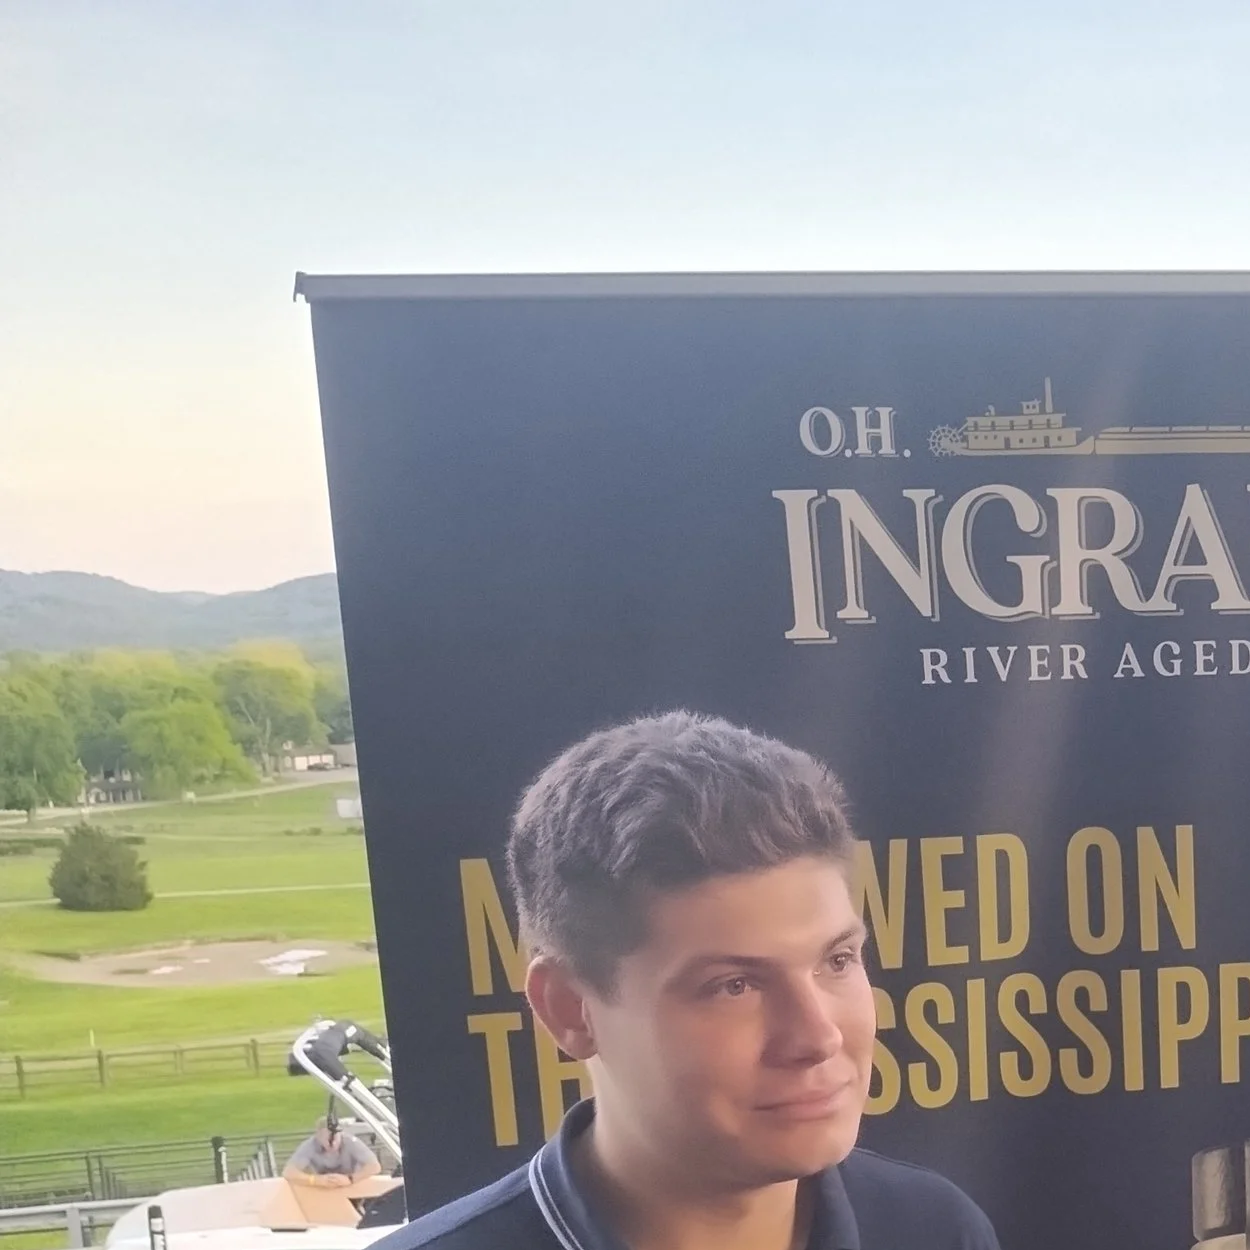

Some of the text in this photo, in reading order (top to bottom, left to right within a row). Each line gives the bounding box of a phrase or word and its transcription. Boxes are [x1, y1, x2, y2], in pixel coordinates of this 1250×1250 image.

[799, 405, 912, 458] O.H.
[920, 643, 1089, 685] RIVER
[1065, 824, 1198, 957] ON
